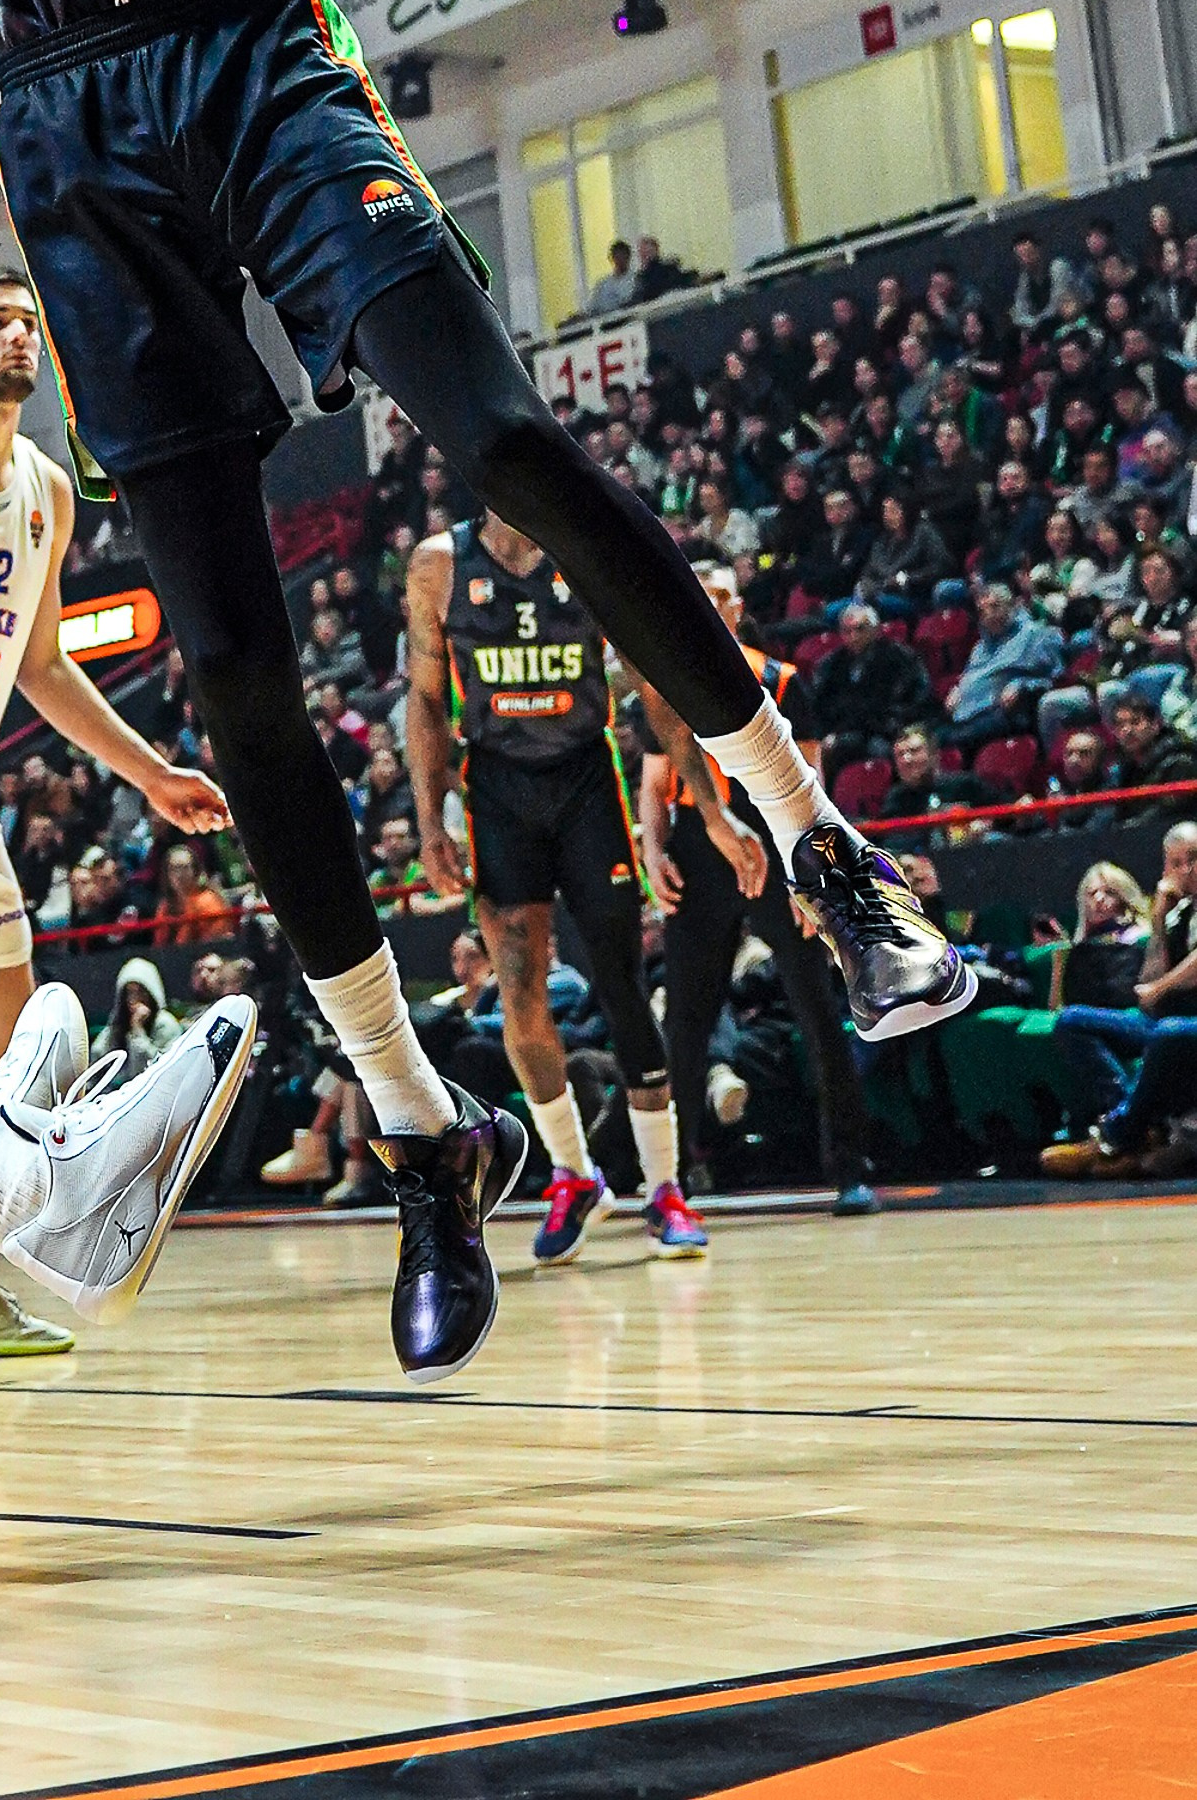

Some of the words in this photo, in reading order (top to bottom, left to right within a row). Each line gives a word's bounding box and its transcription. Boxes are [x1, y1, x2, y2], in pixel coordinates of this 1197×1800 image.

[363, 193, 414, 217] UNICS
[515, 600, 538, 640] 3
[473, 643, 583, 684] UNICS
